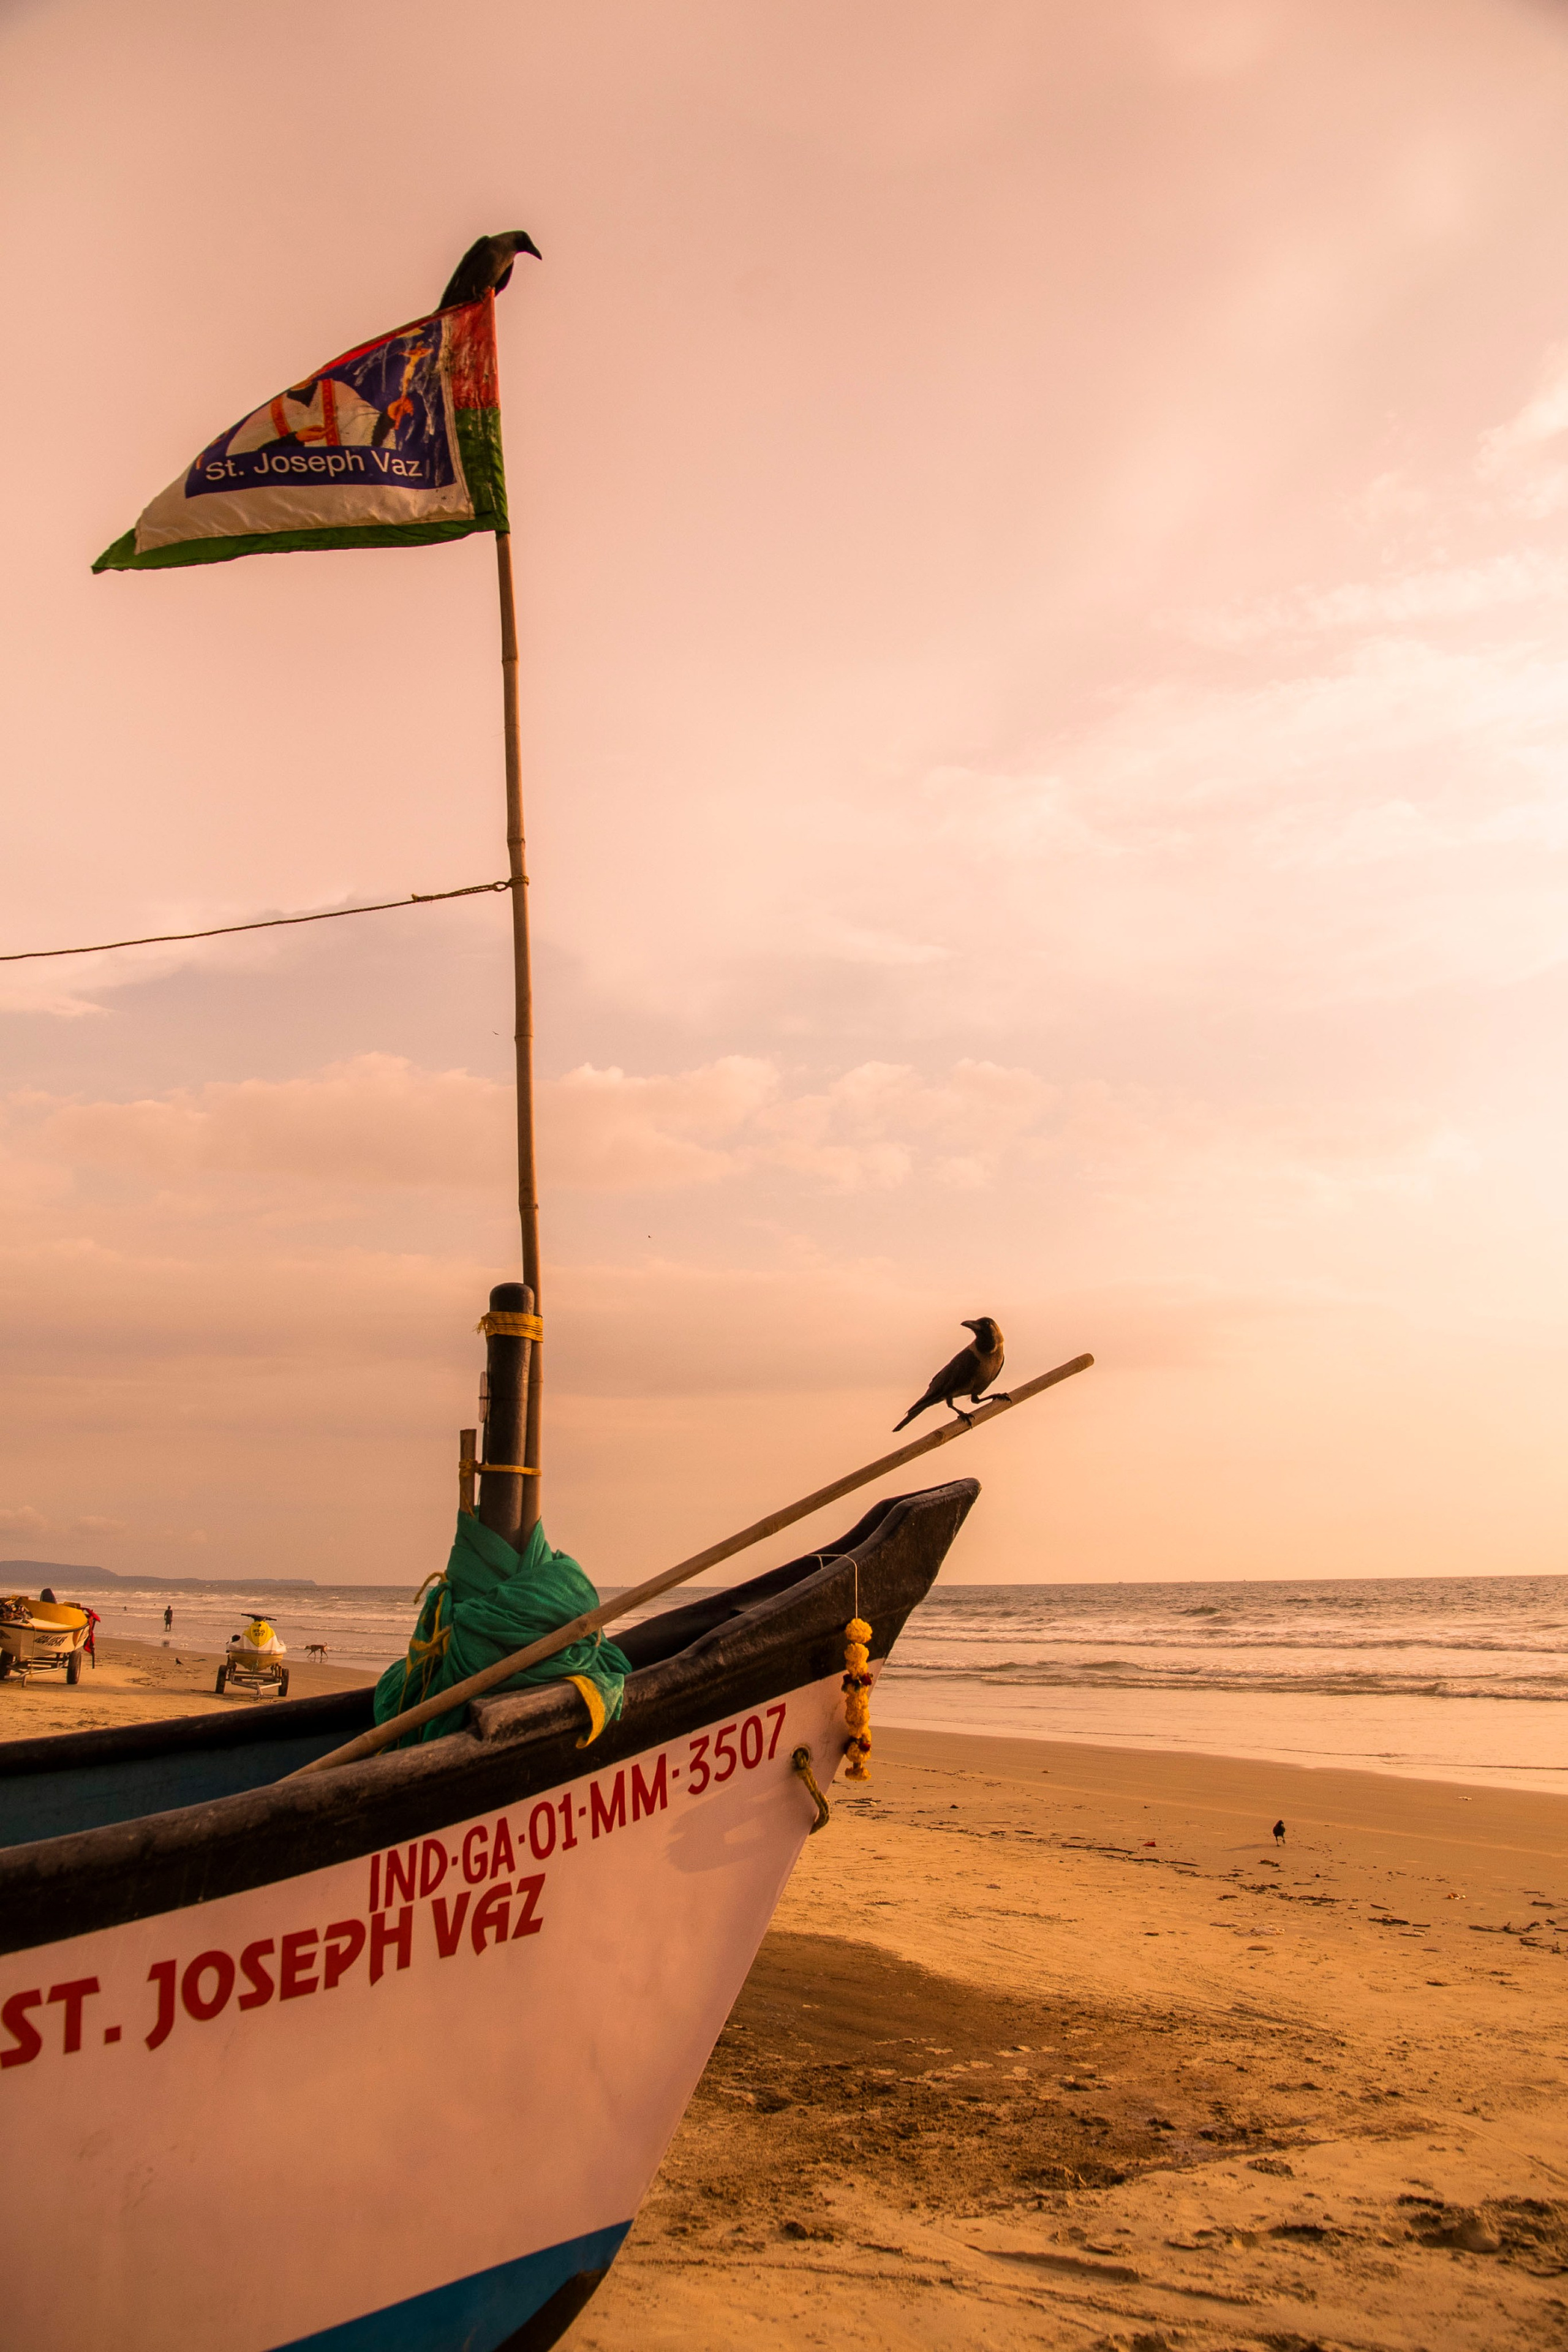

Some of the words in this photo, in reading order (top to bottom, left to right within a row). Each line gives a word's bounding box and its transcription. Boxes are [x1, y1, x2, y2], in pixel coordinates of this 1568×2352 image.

[205, 459, 244, 481] St.
[254, 449, 366, 477] Joseph
[371, 450, 423, 477] Vaz
[0, 1976, 121, 2069] ST.
[145, 1905, 413, 2051] JOSEPH
[431, 1872, 546, 1958] VAZ
